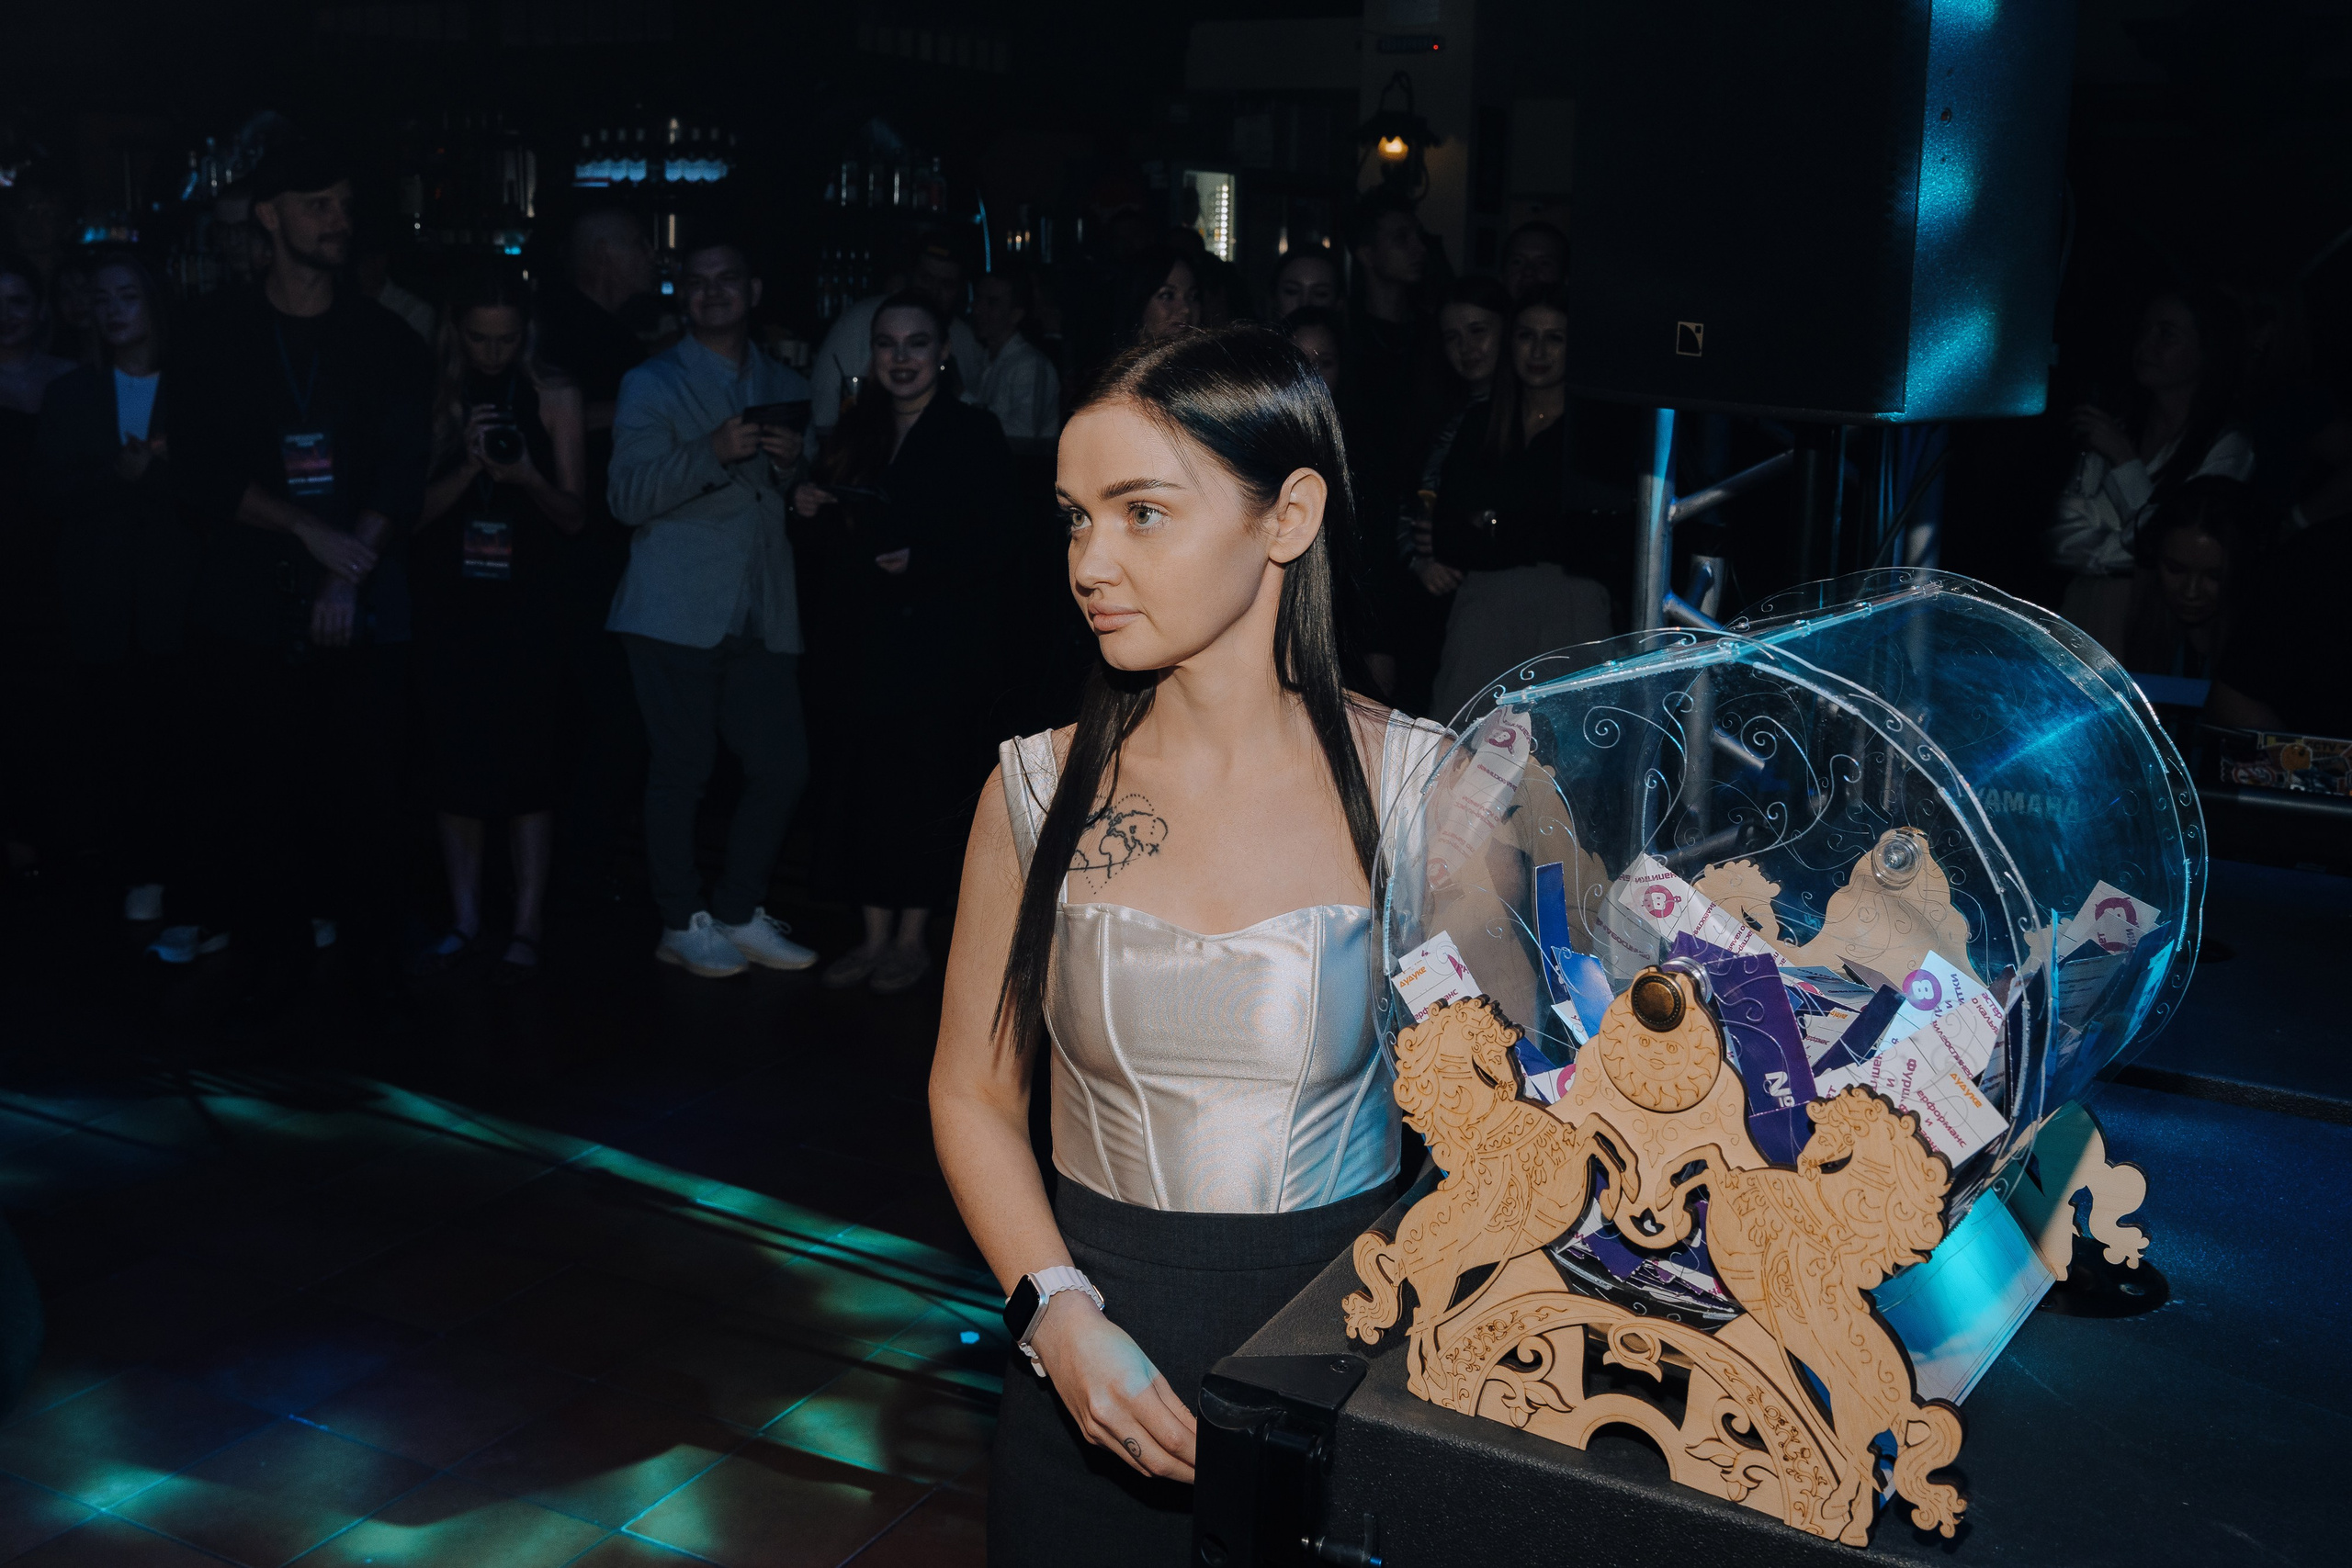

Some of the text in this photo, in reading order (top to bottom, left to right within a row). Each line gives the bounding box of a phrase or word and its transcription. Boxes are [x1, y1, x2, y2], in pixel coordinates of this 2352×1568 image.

[1399, 965, 1426, 987] дудуке
[1949, 1072, 1983, 1109] дудуке
[1917, 1089, 1967, 1148] ерформанс
